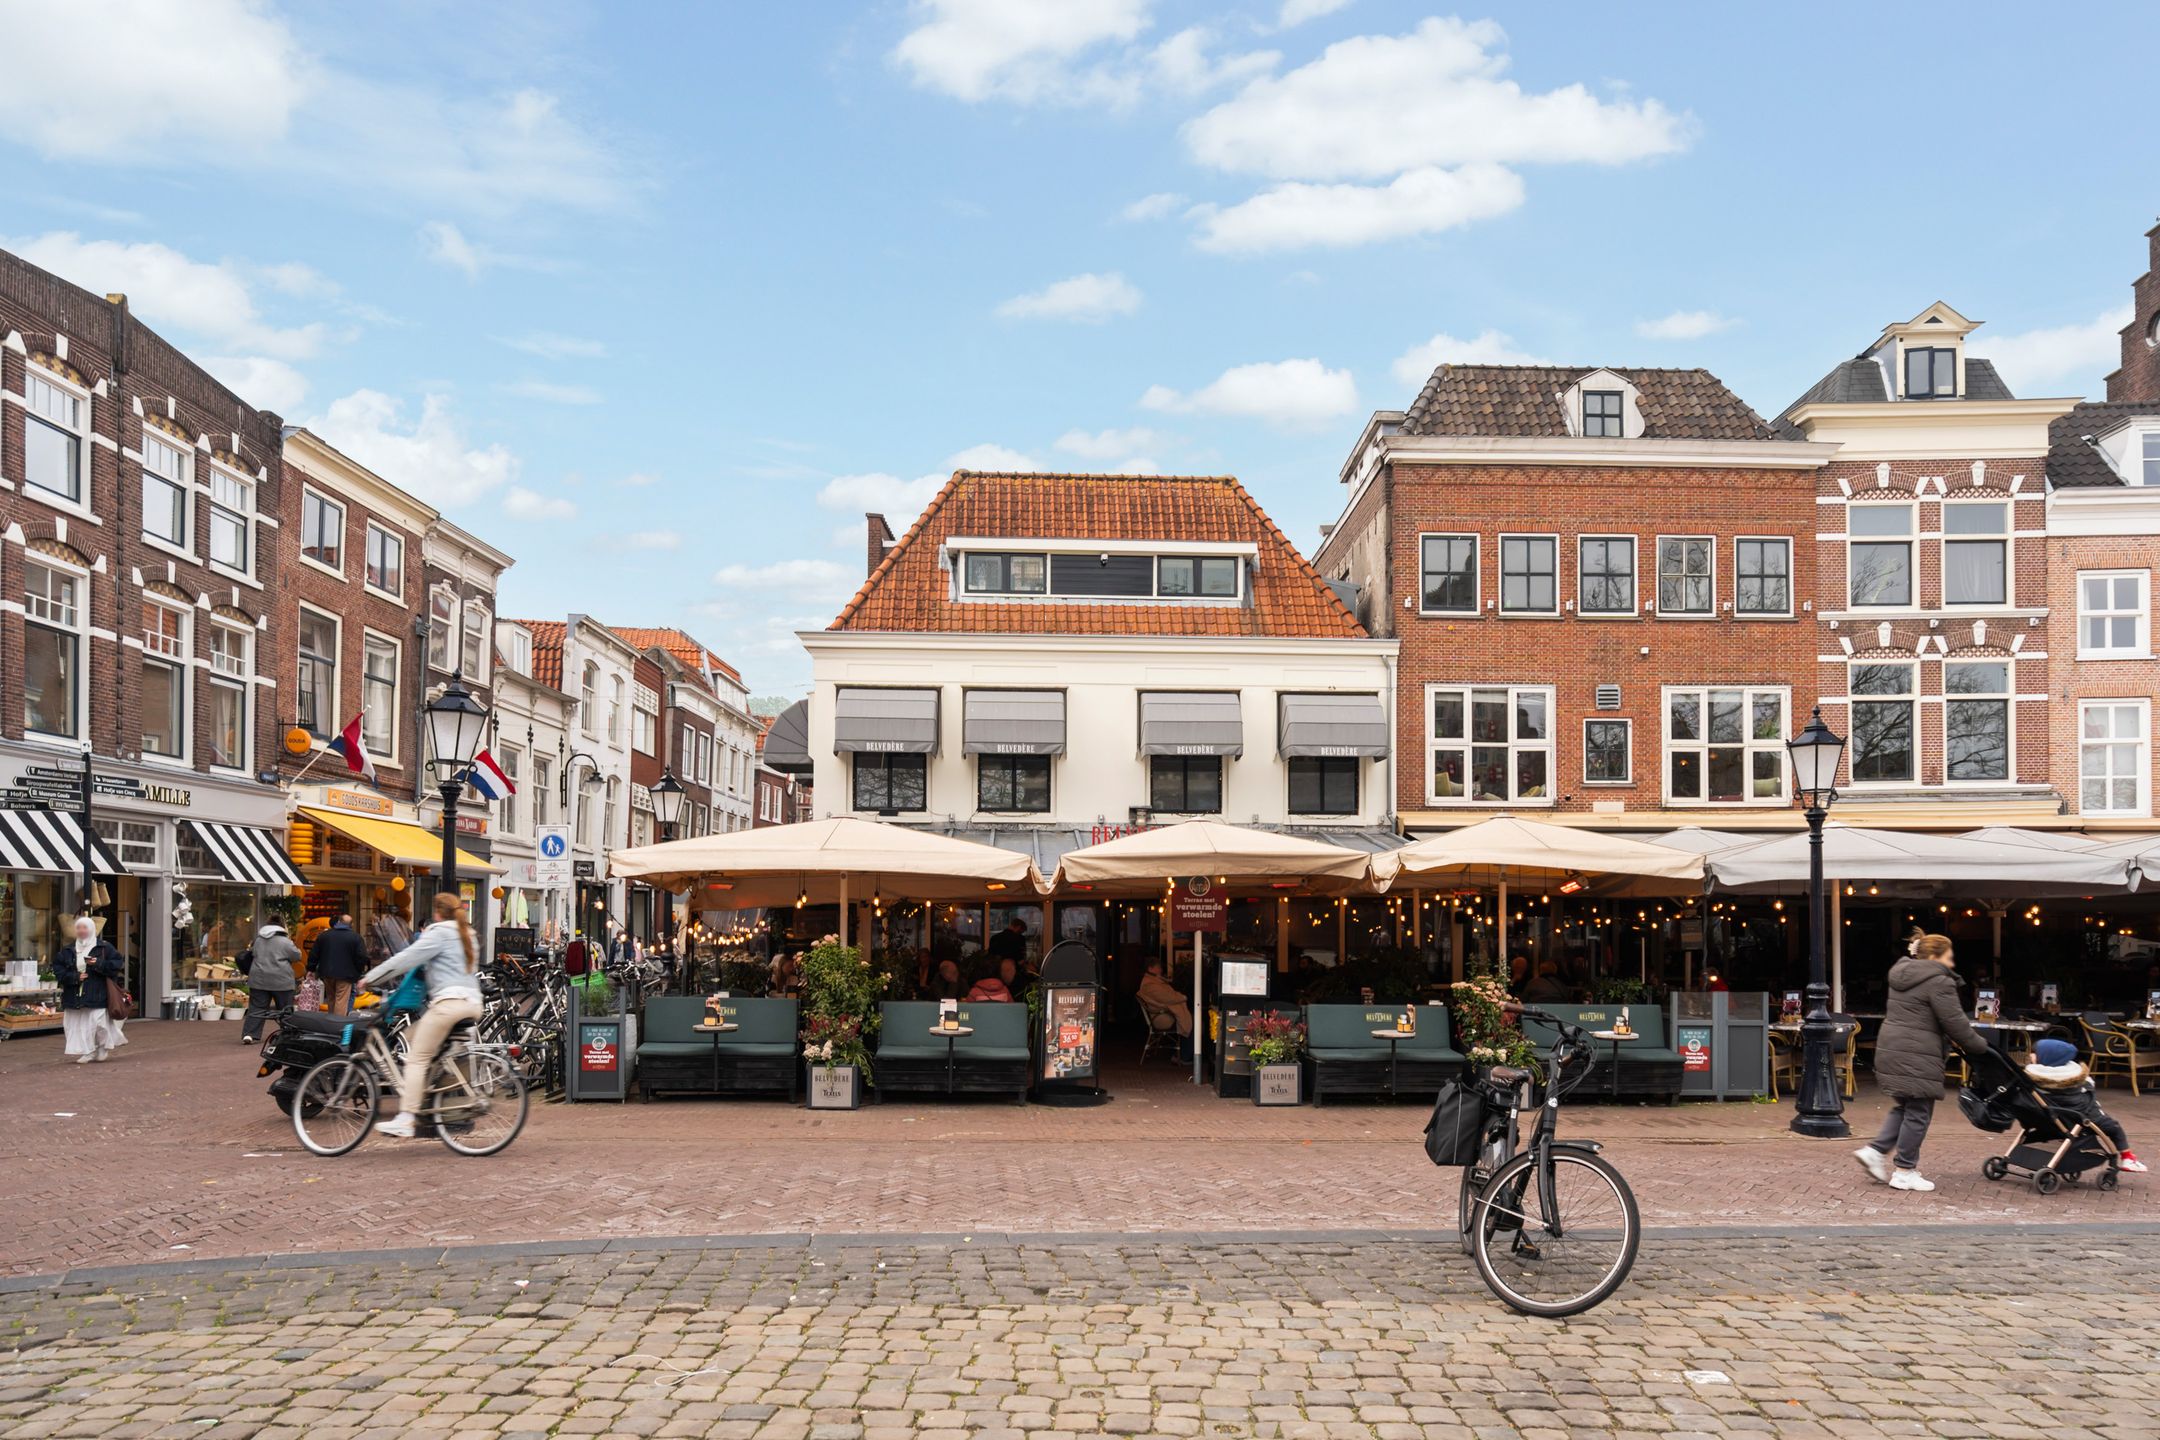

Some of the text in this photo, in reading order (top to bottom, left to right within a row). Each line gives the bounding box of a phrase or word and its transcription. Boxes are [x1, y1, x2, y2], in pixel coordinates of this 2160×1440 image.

[866, 740, 904, 752] BELVEDÈRE
[997, 743, 1035, 753] BELVEDÈRE
[1177, 744, 1214, 754] BELVEDÈRE
[1321, 746, 1358, 756] BELVEDÈRE
[144, 784, 191, 806] AMILLE
[1175, 903, 1223, 911] verwarmde
